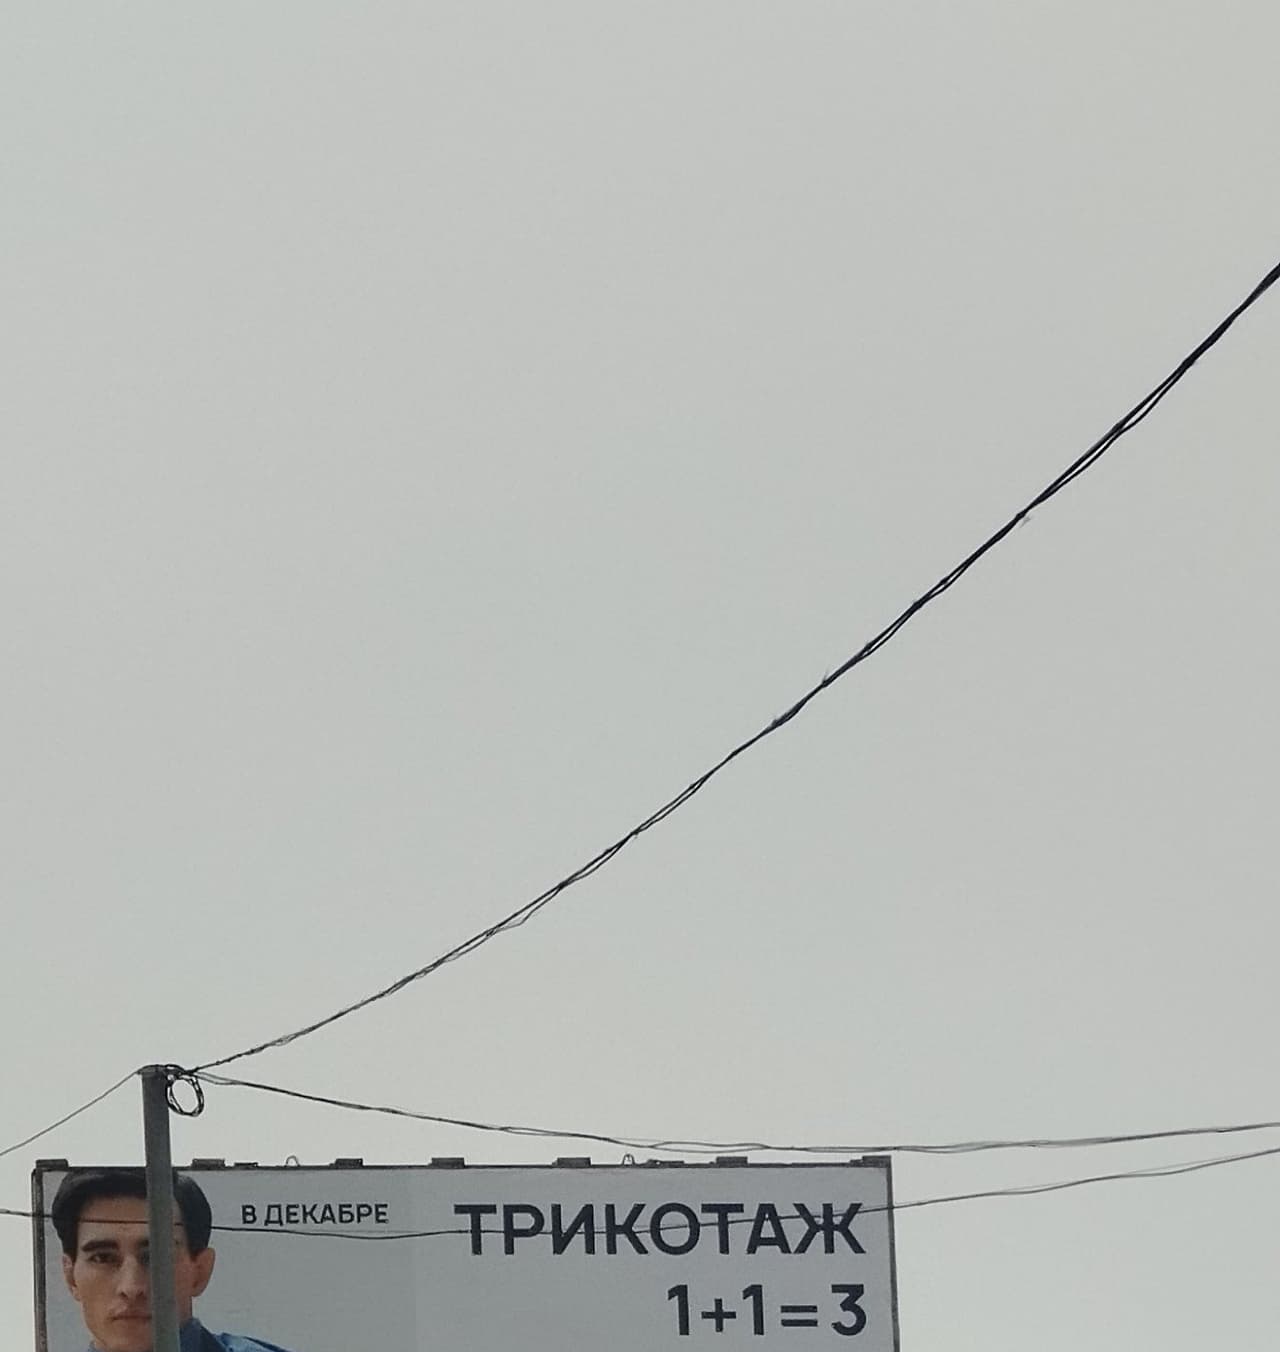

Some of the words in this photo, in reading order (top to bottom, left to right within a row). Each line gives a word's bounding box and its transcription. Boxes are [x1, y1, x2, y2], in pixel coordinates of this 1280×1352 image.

[242, 1204, 257, 1224] В
[264, 1203, 389, 1226] ДЕКАБРЕ
[454, 1202, 867, 1256] ТРИКОТАЖ
